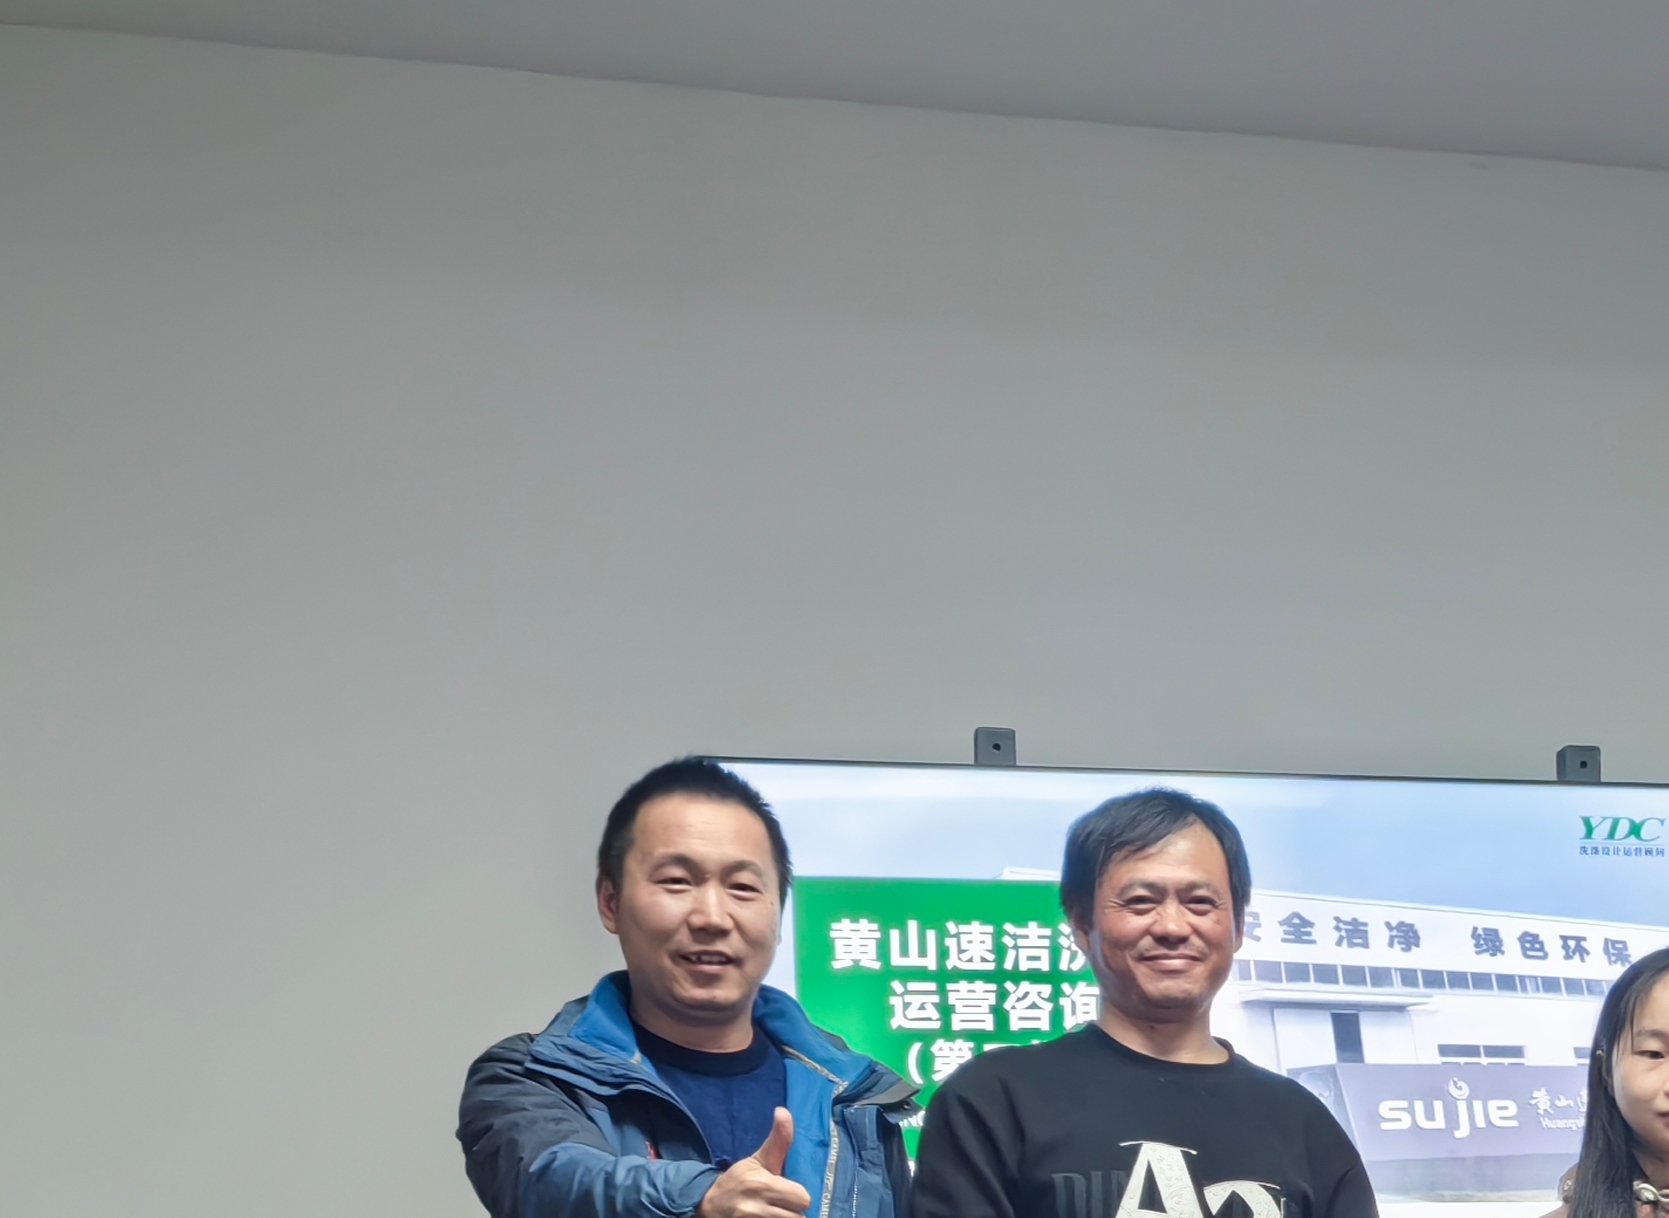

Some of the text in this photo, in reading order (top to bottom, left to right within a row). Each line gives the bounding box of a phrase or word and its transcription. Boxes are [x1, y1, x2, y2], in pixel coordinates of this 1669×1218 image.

[1579, 815, 1666, 842] YDC
[1470, 926, 1633, 968] 绿色环保
[889, 979, 1100, 1032] 运营咨询
[1378, 1097, 1519, 1139] sujie
